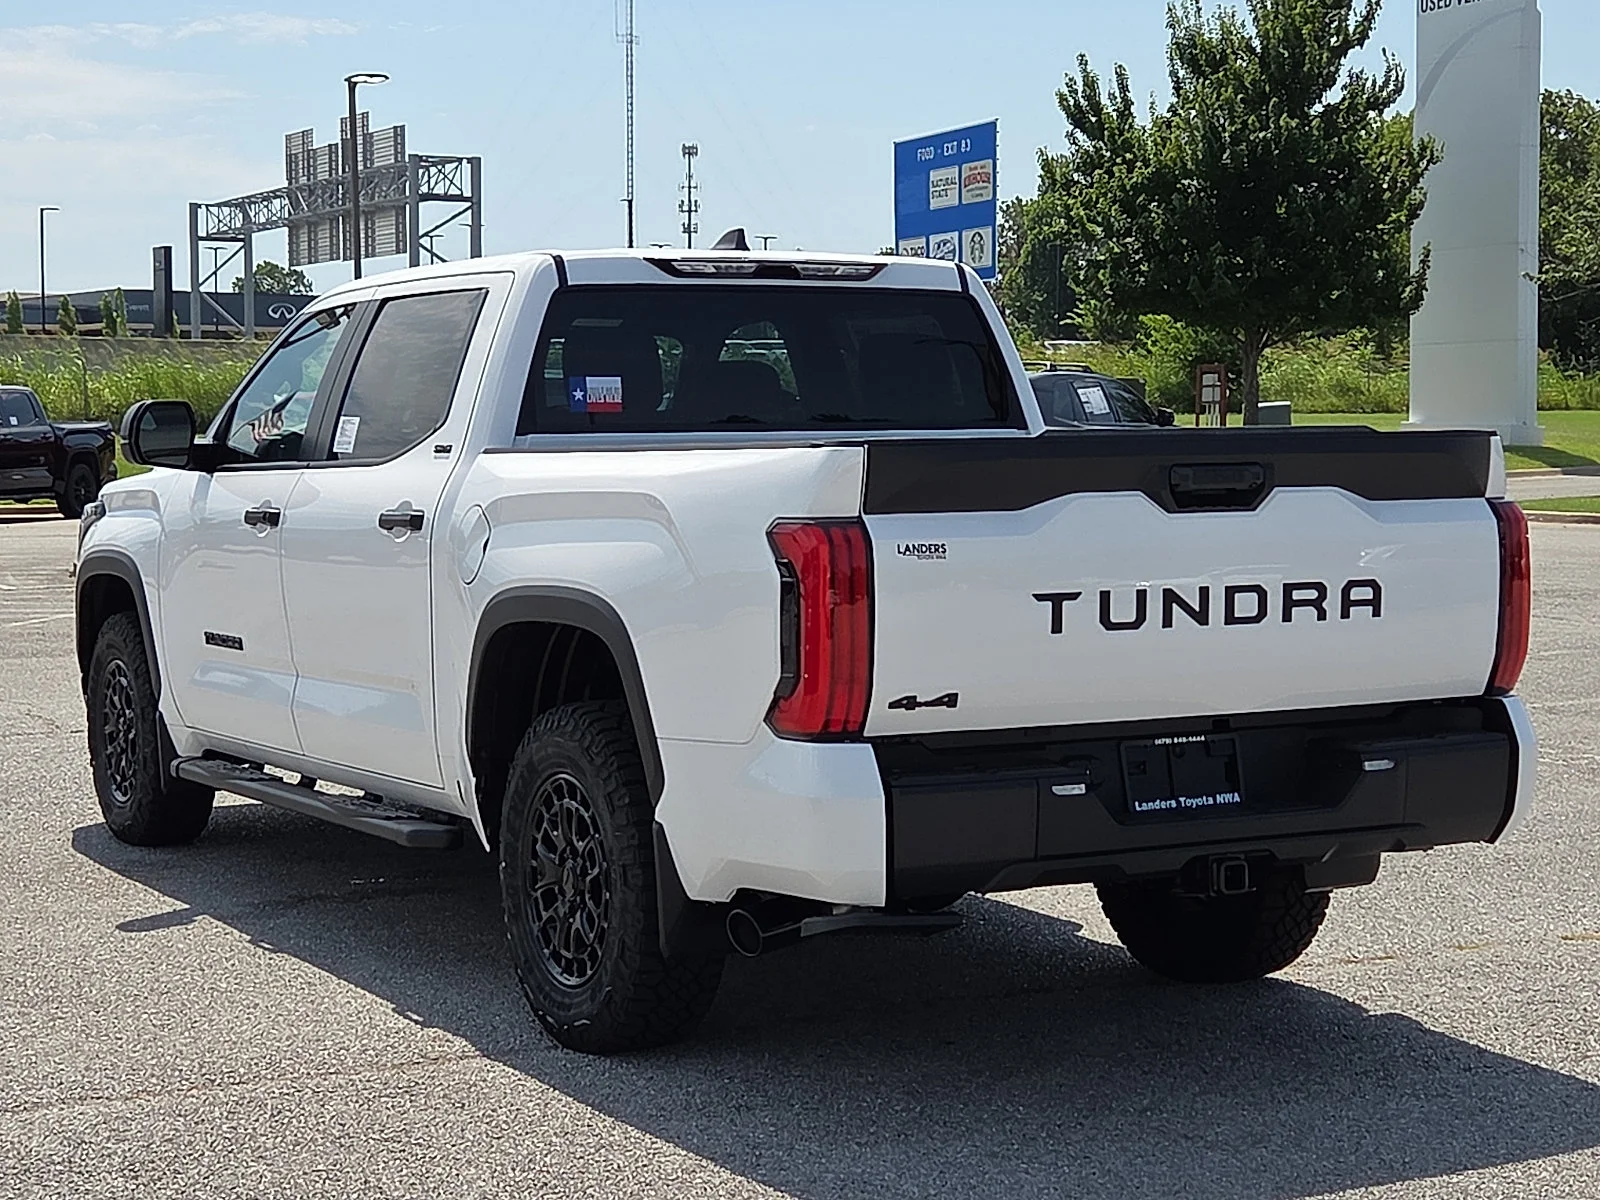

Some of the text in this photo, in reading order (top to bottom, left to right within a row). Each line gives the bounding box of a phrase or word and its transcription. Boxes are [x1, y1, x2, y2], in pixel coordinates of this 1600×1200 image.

[917, 146, 935, 162] FOOD
[943, 141, 958, 156] EXIT
[931, 176, 958, 189] NATURAL
[931, 188, 949, 200] STATE
[897, 543, 947, 556] LANDERS
[1031, 578, 1382, 635] TUNDRA
[1134, 792, 1241, 811] Landers Toyota NWA
